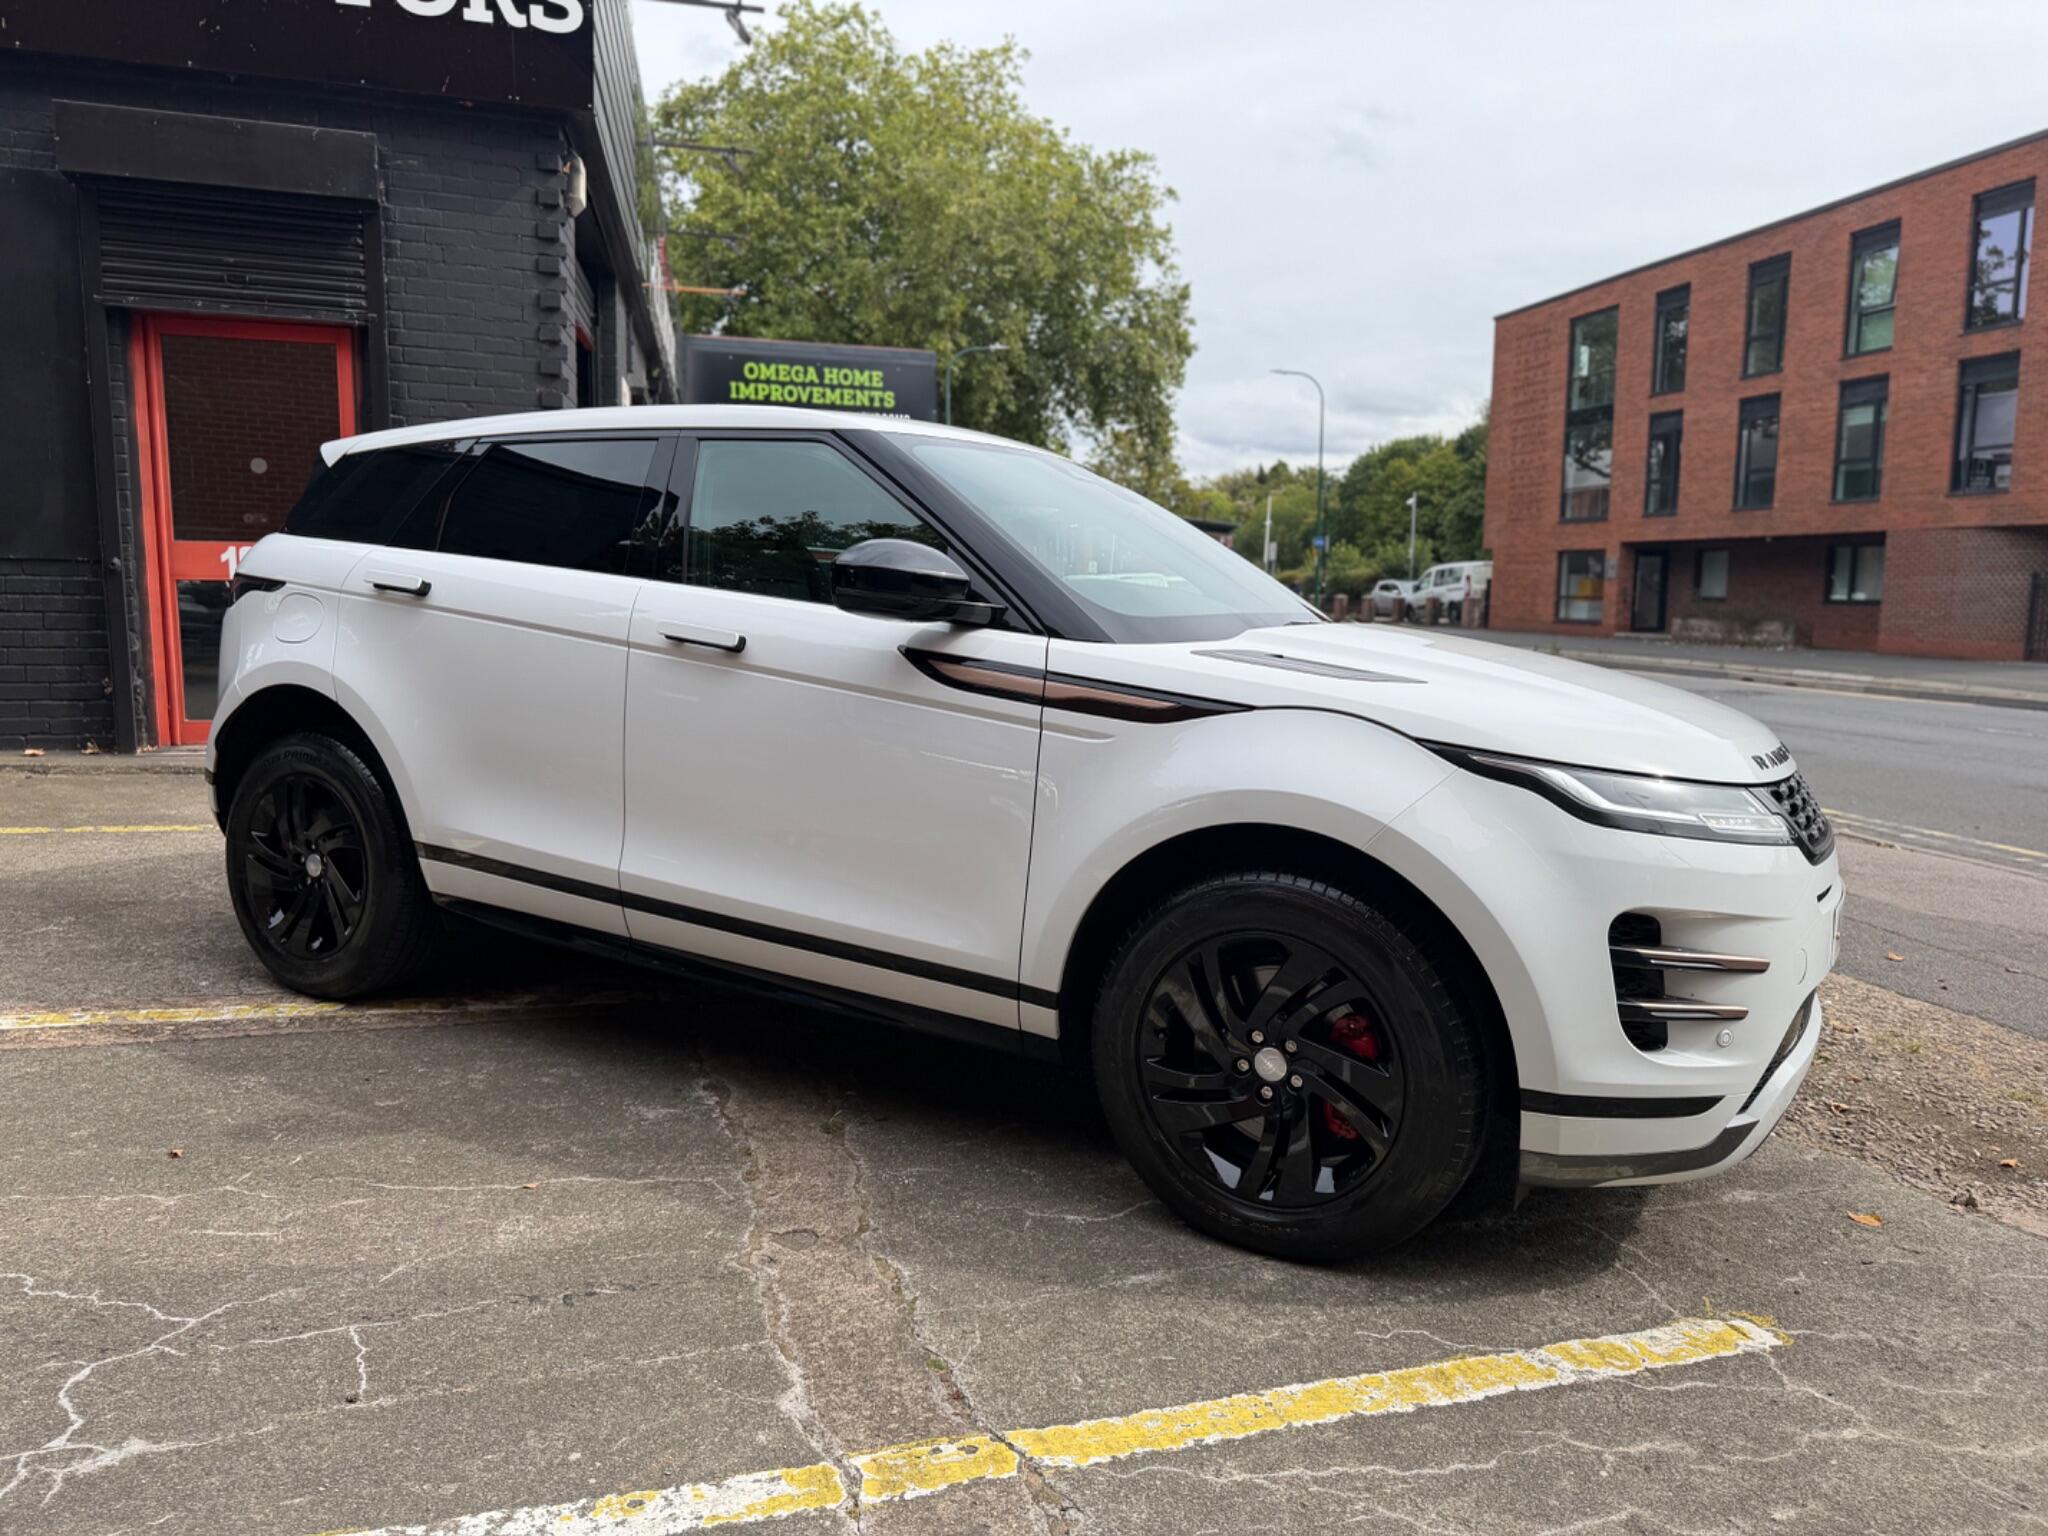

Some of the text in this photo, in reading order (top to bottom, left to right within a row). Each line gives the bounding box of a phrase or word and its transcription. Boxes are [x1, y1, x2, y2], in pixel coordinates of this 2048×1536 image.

[743, 362, 883, 389] OMEGA HOME
[729, 381, 896, 408] IMPROVEMENTS
[220, 545, 252, 579] 1
